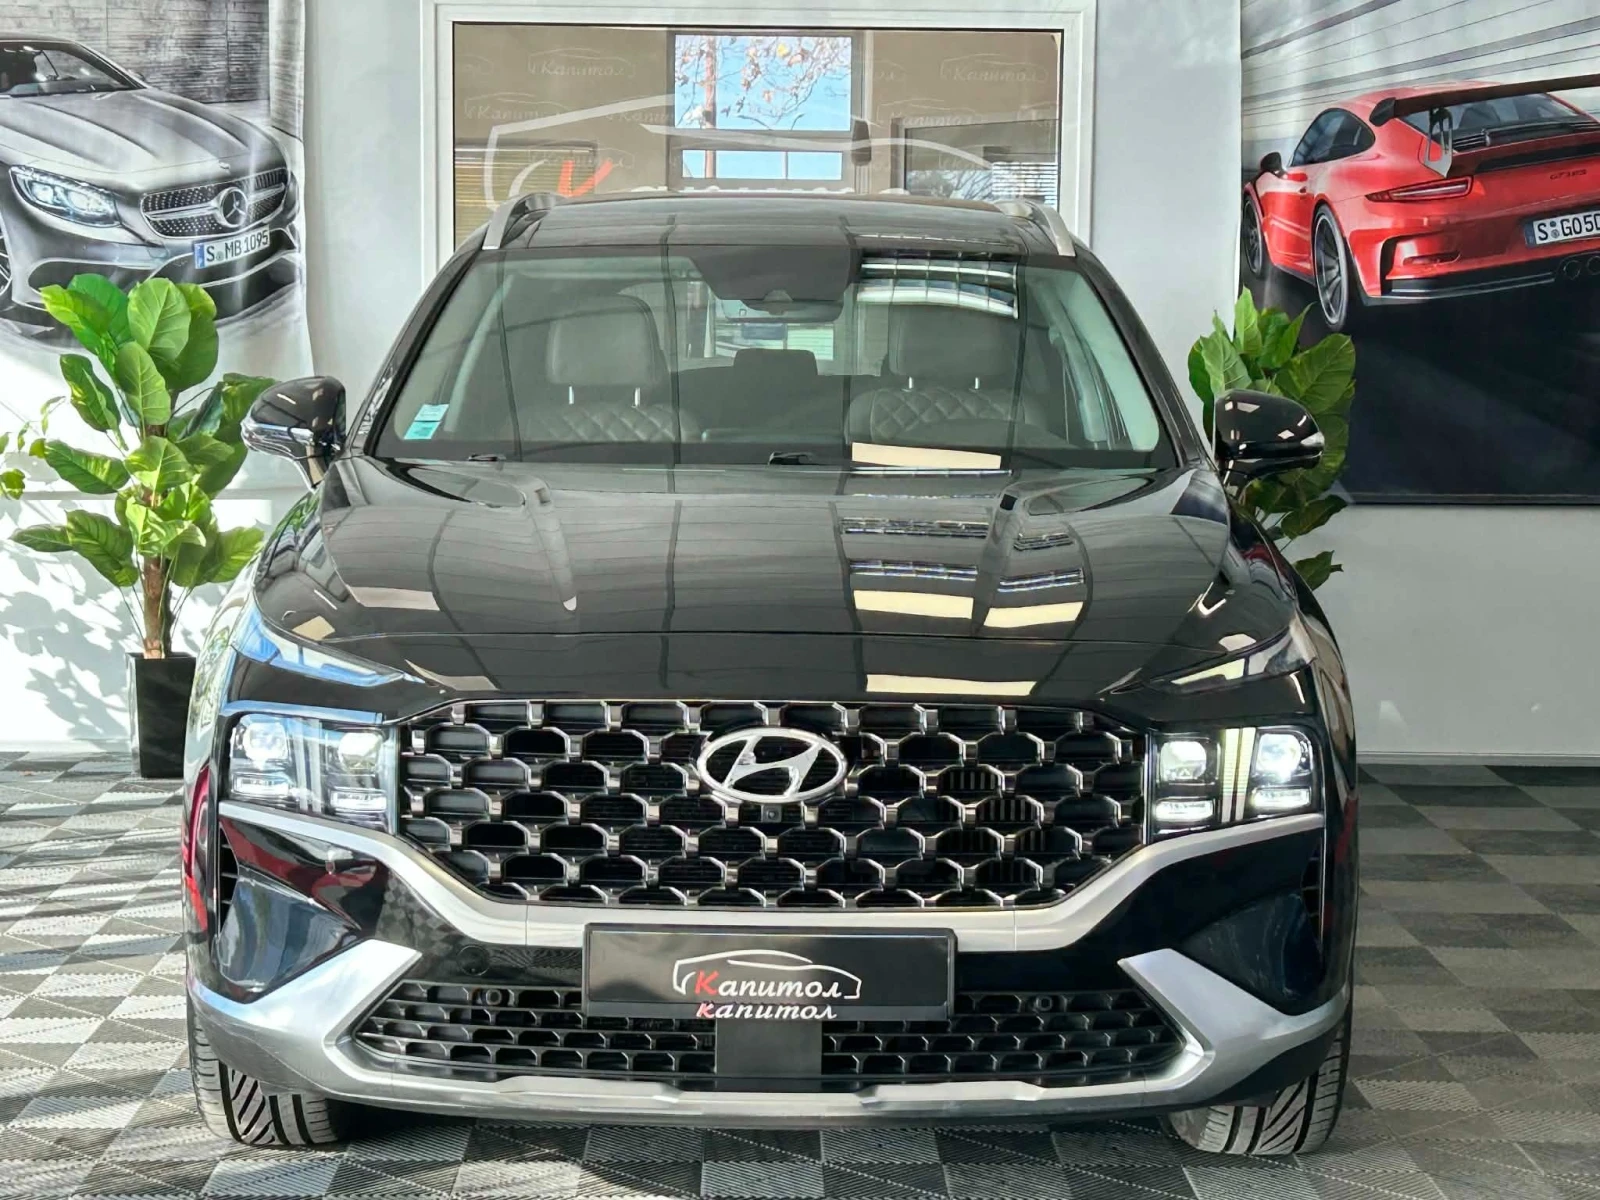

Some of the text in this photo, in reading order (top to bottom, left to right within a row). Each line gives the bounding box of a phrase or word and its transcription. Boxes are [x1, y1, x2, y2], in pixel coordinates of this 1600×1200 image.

[1537, 222, 1549, 241] S
[206, 245, 215, 262] S
[695, 969, 842, 998] Капитол
